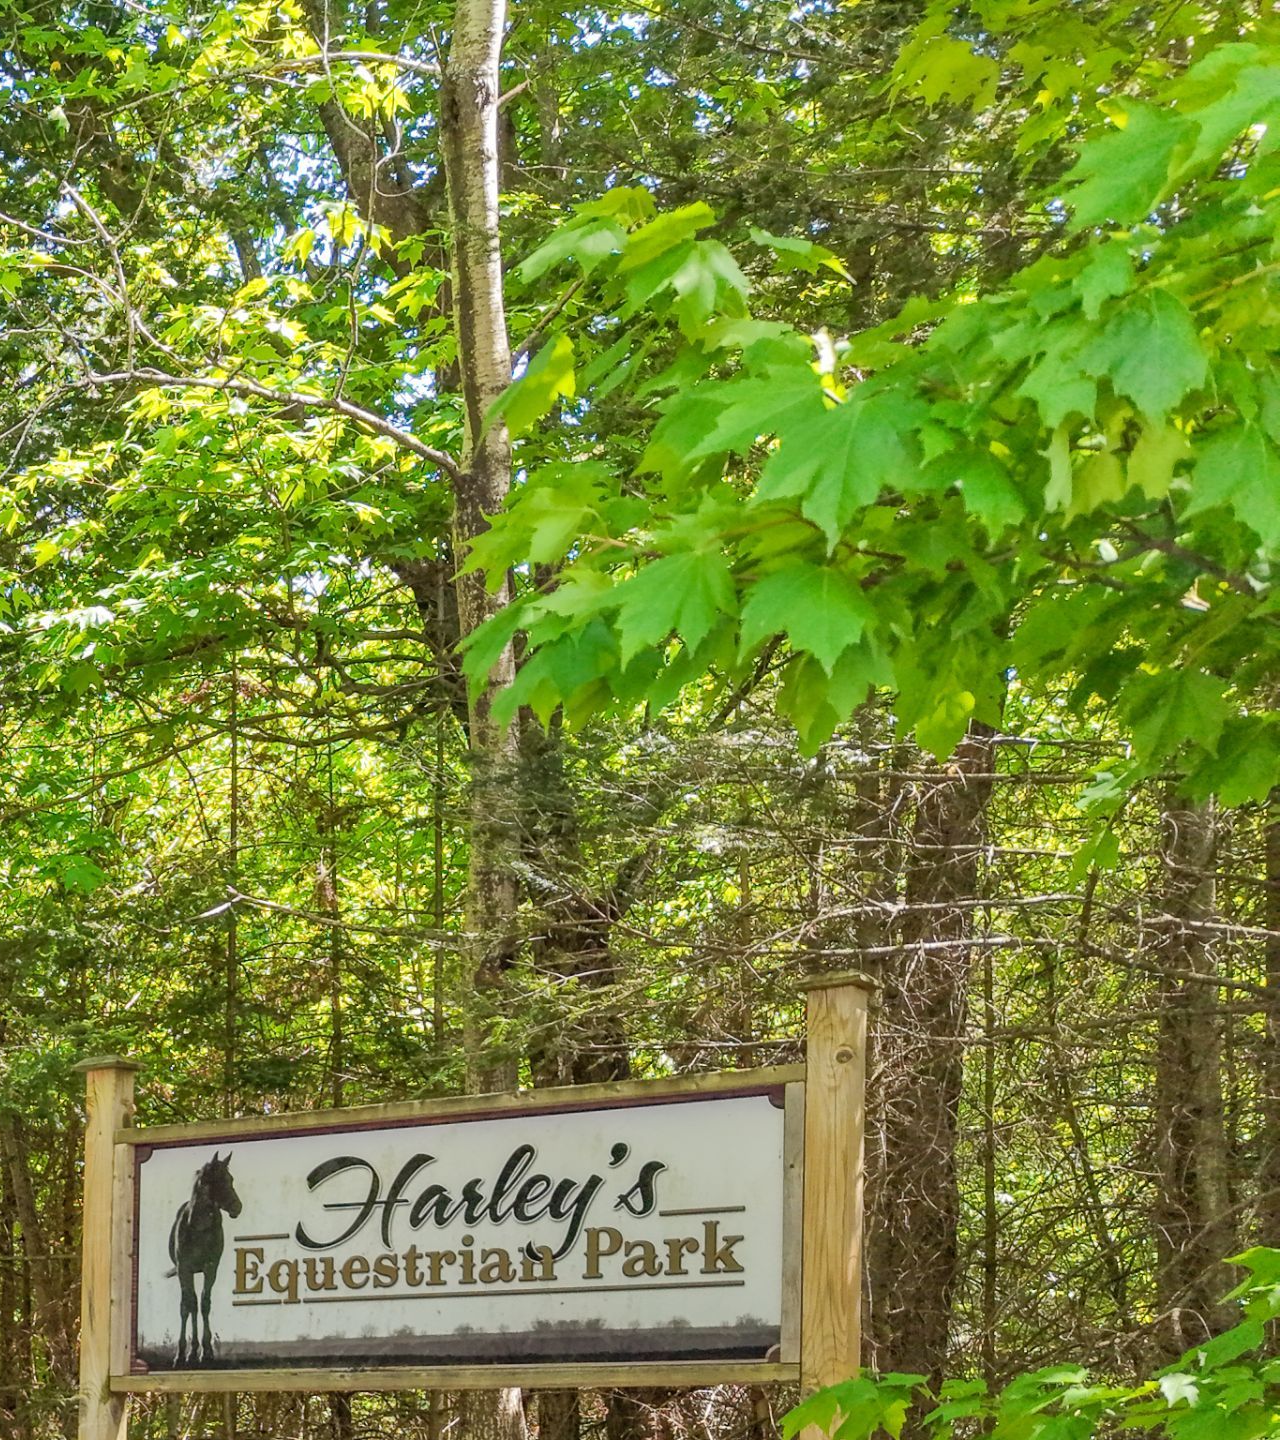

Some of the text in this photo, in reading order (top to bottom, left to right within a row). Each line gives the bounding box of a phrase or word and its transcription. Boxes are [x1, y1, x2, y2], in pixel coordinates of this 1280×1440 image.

[295, 1142, 669, 1264] Harley's
[232, 1219, 744, 1301] Equestrian Park
